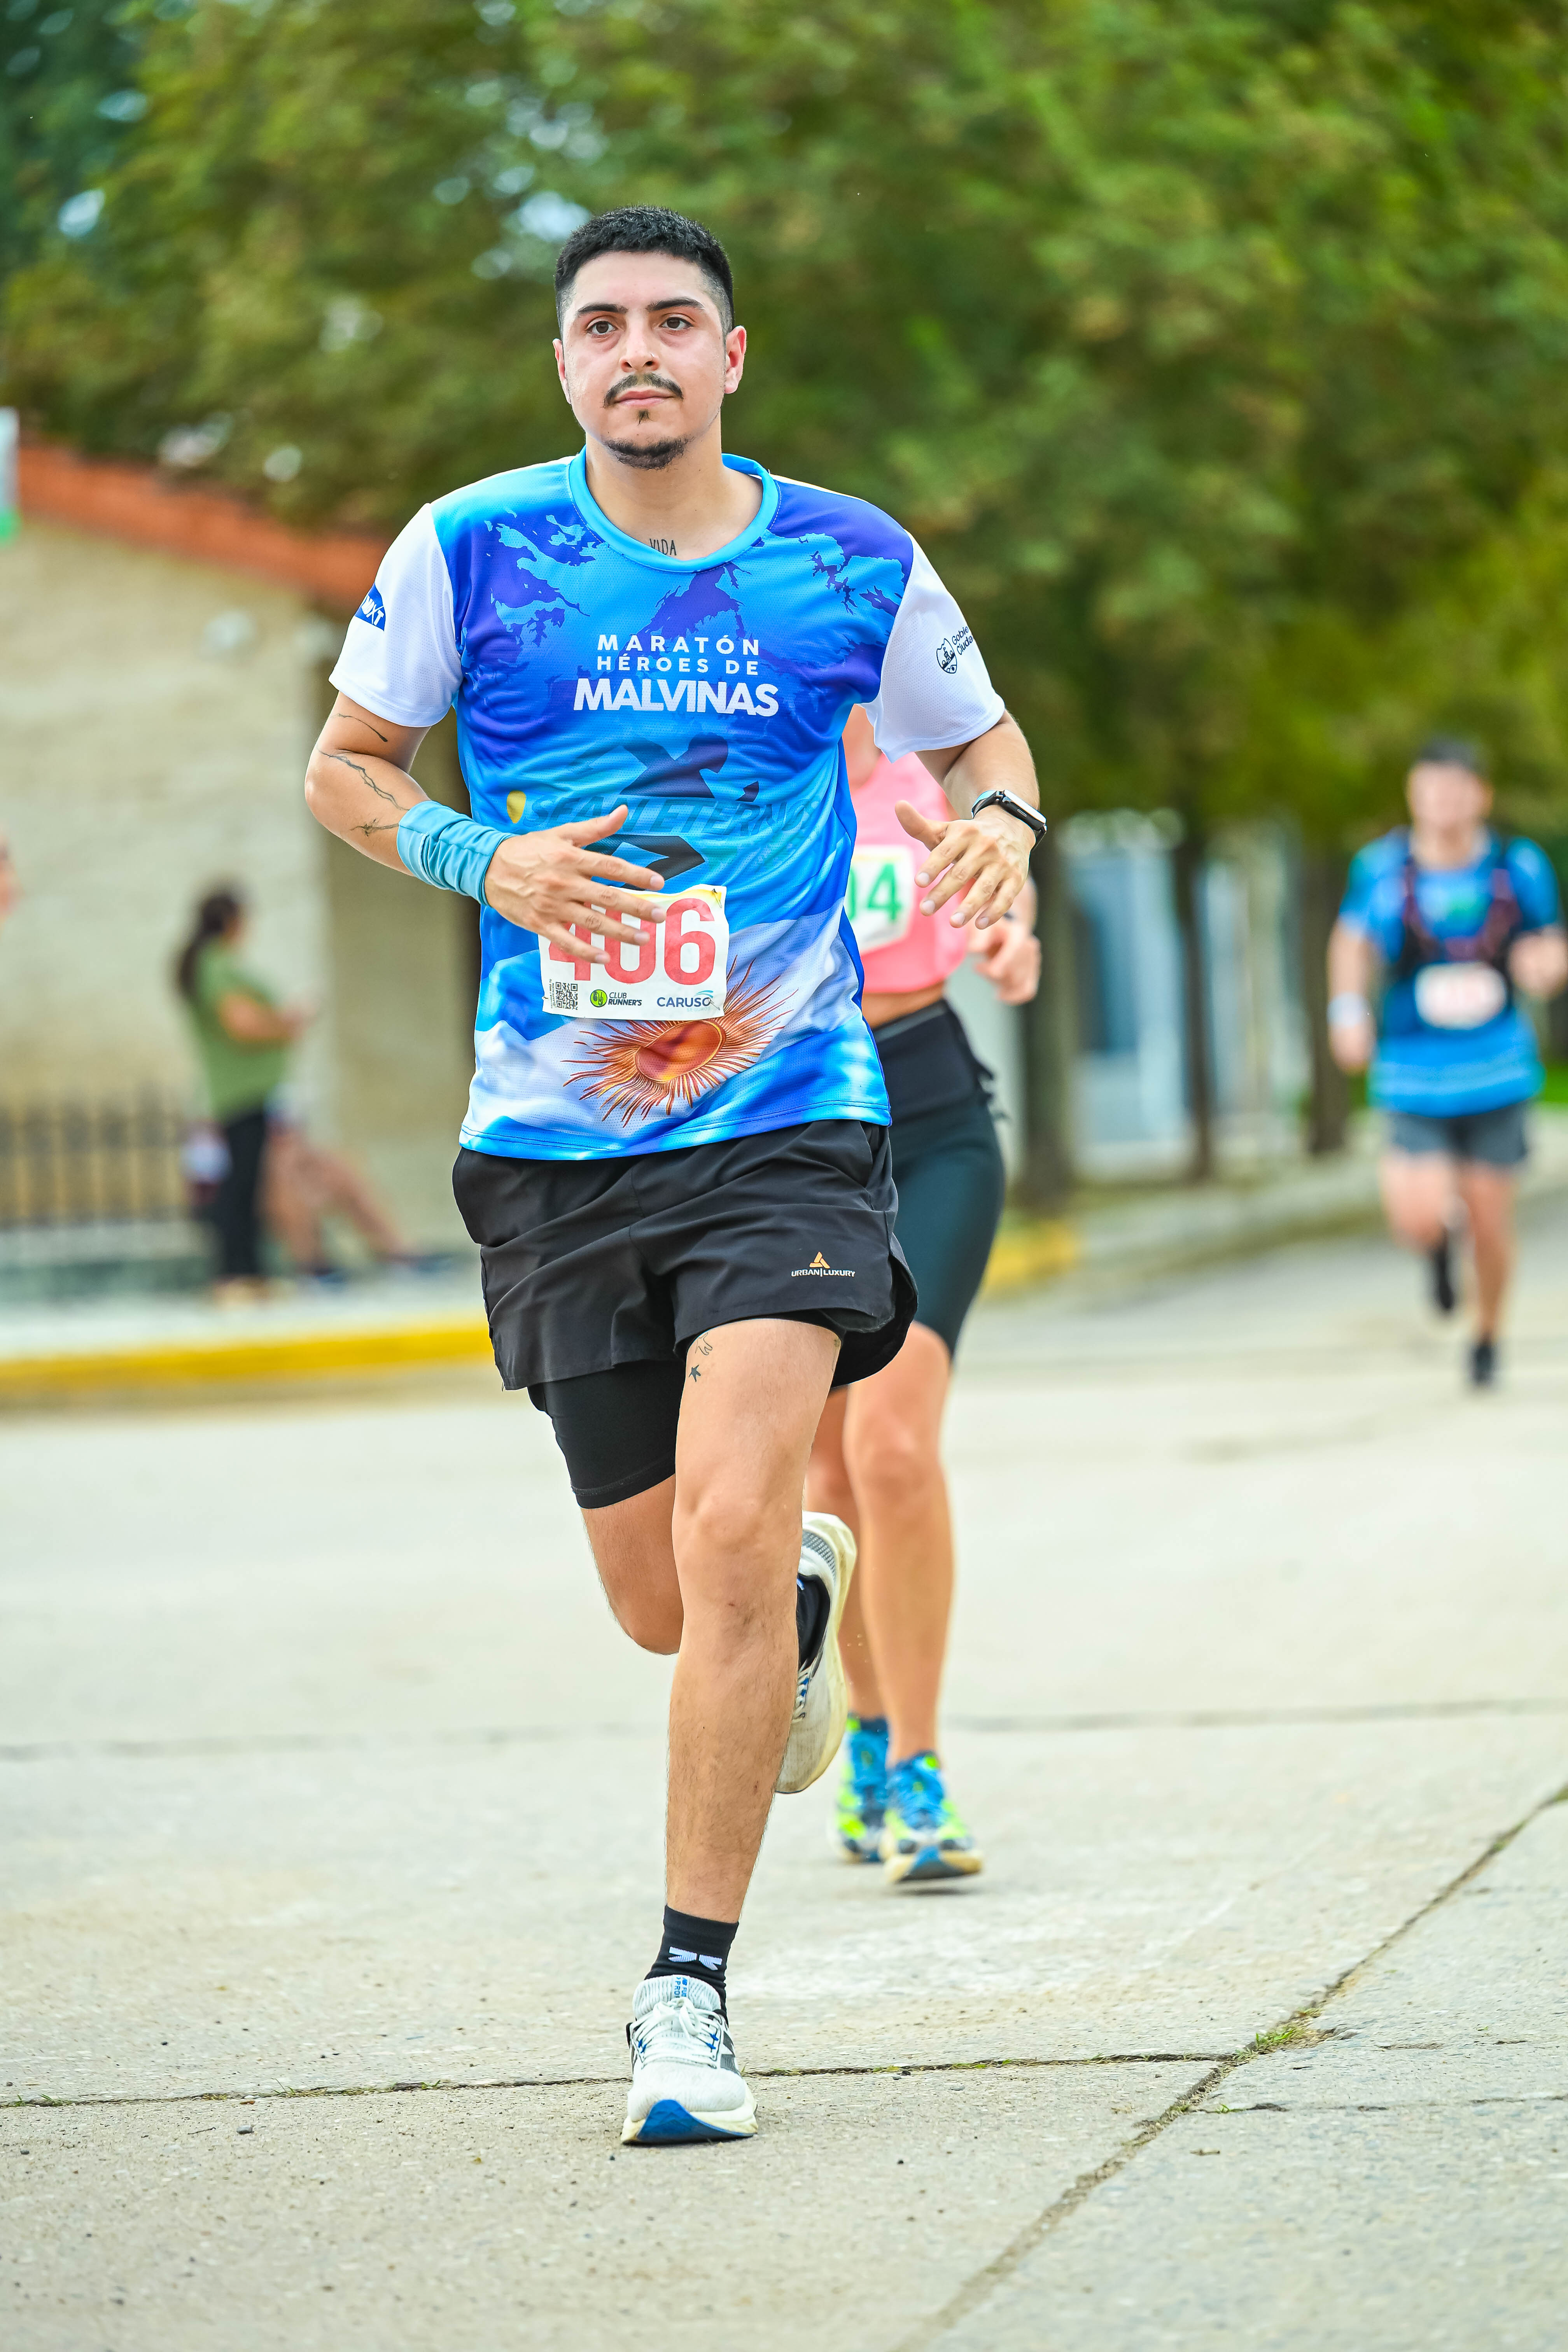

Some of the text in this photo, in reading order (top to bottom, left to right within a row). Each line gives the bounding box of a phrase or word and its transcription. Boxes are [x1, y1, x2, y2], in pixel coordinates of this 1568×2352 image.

[649, 539, 677, 555] VIDA
[597, 634, 759, 656] MARATÓN
[597, 653, 758, 675] HÉROES DE
[573, 678, 779, 717] MALVINAS
[549, 898, 716, 985] 406
[657, 997, 711, 1008] CARUSO
